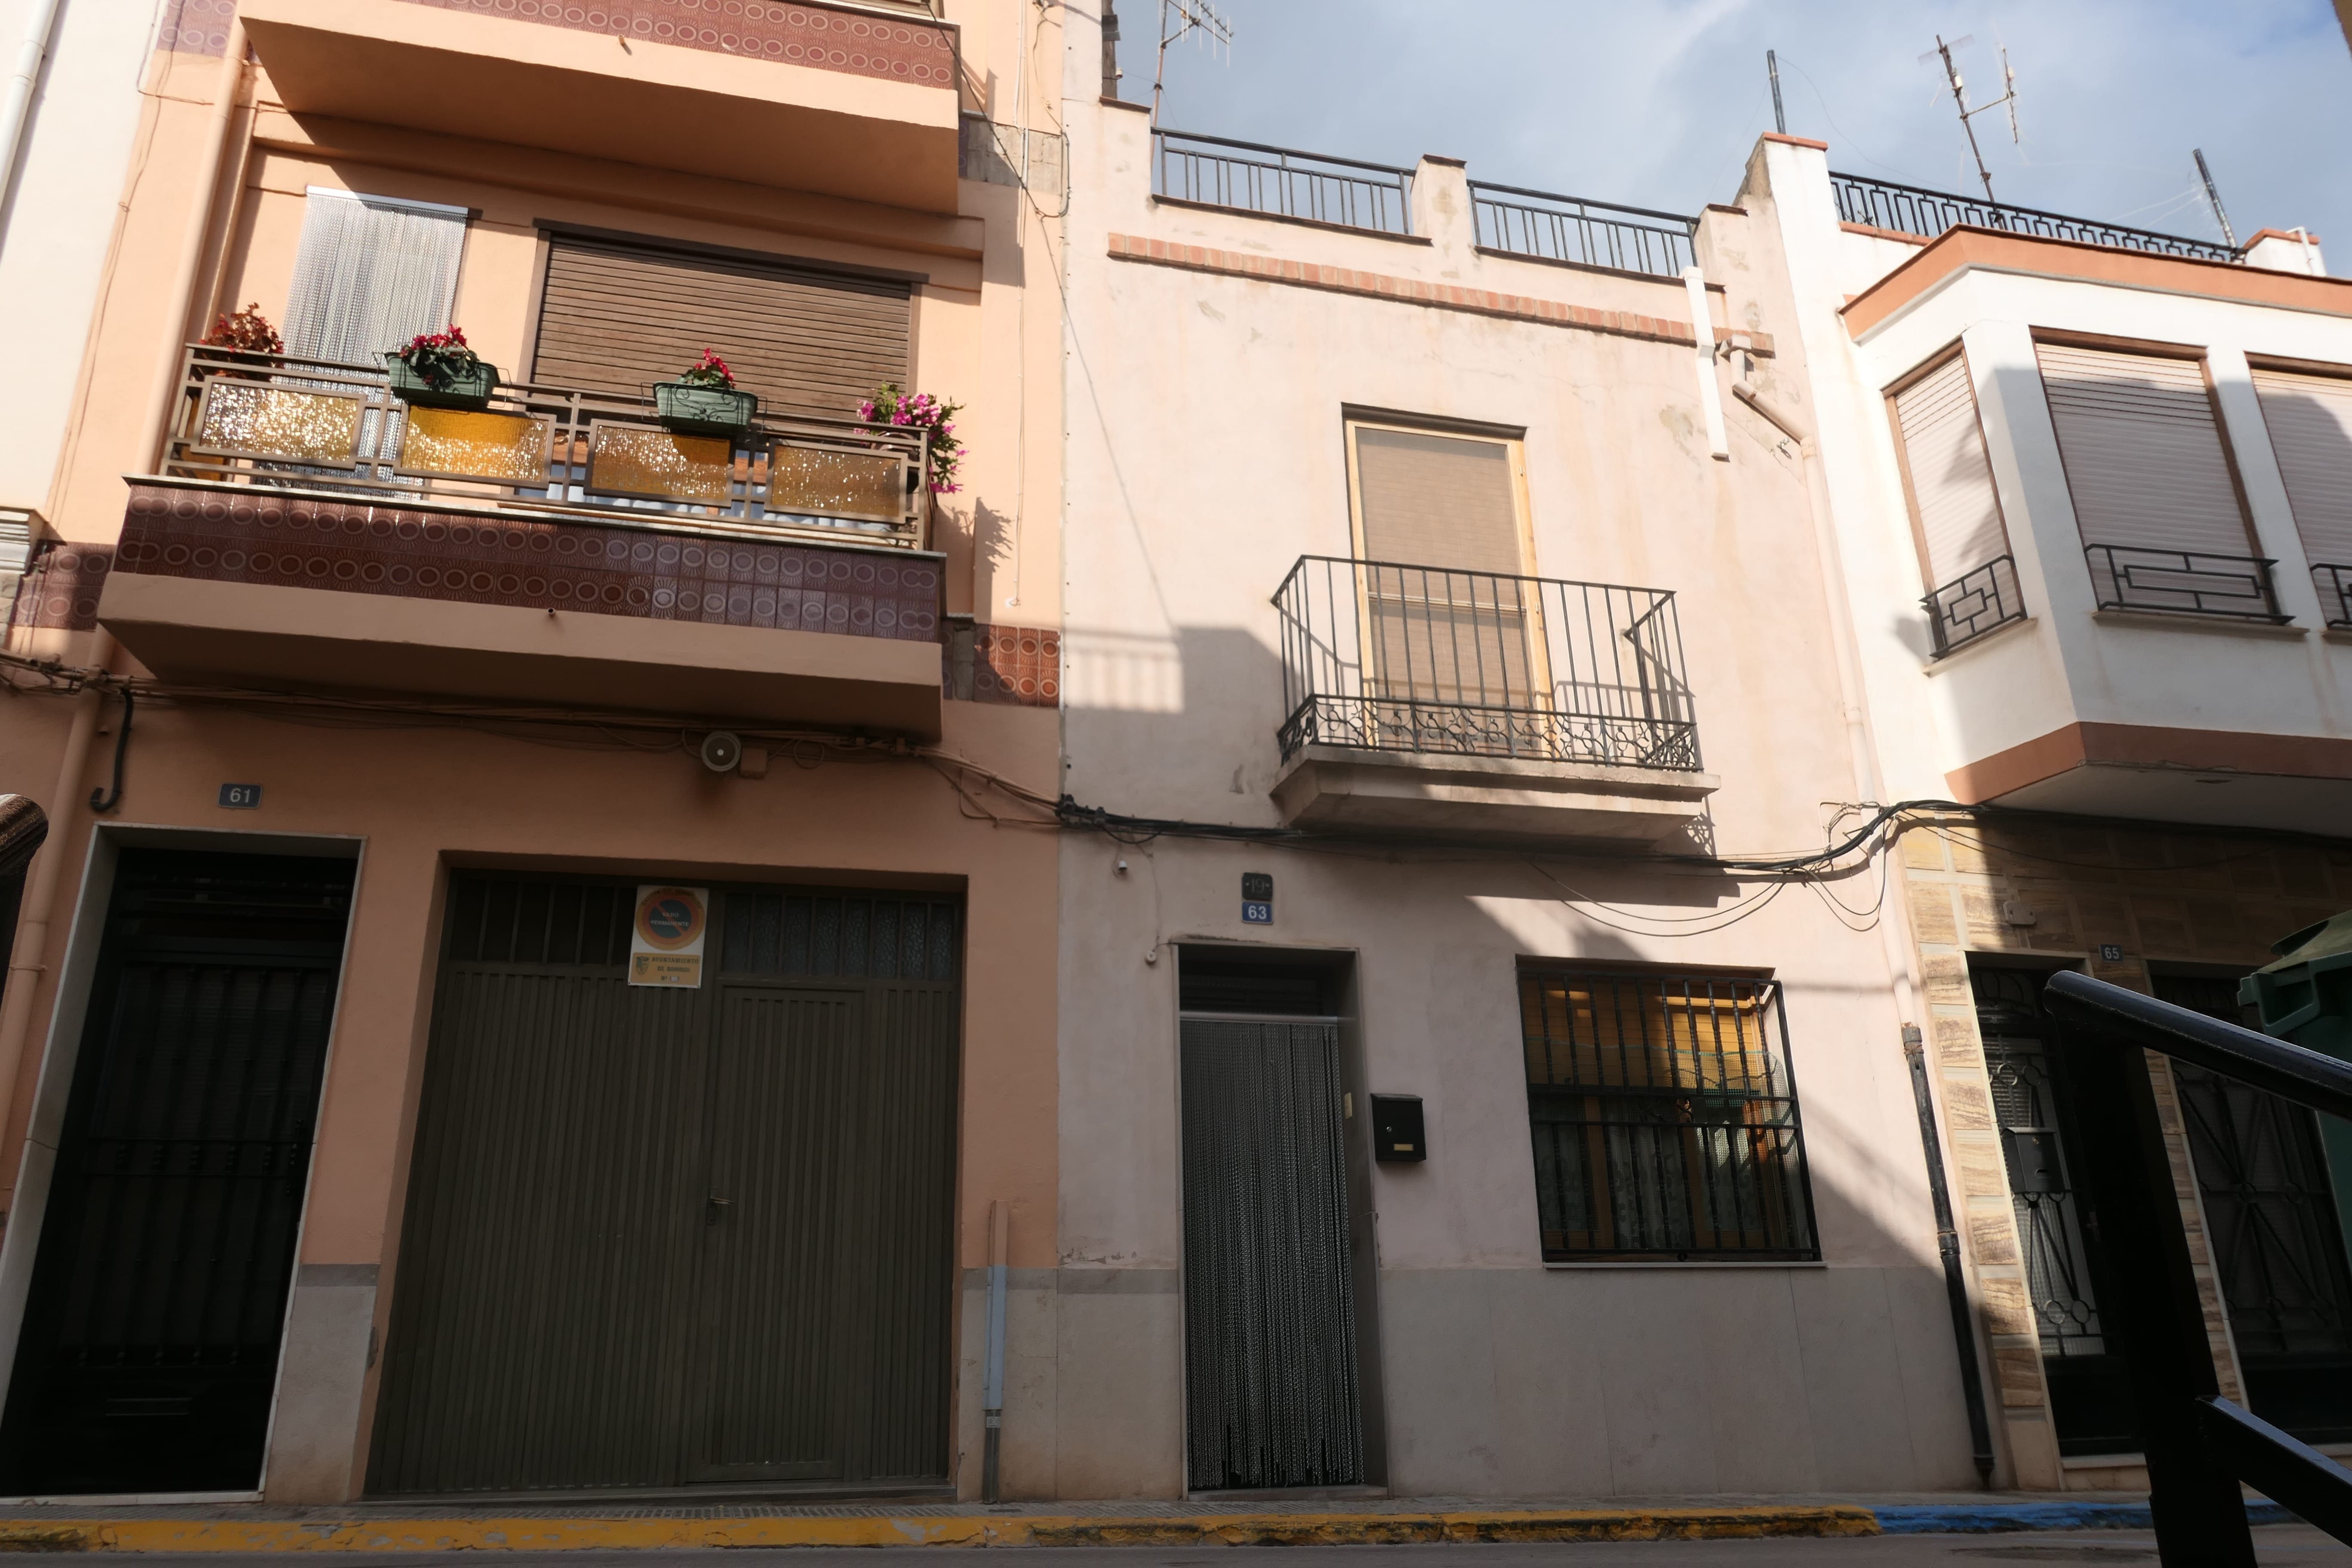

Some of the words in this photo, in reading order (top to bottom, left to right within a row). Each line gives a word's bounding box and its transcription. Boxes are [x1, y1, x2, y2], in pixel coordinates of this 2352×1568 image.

[230, 787, 251, 802] 61
[1248, 905, 1267, 919] 63
[2105, 947, 2119, 959] 65
